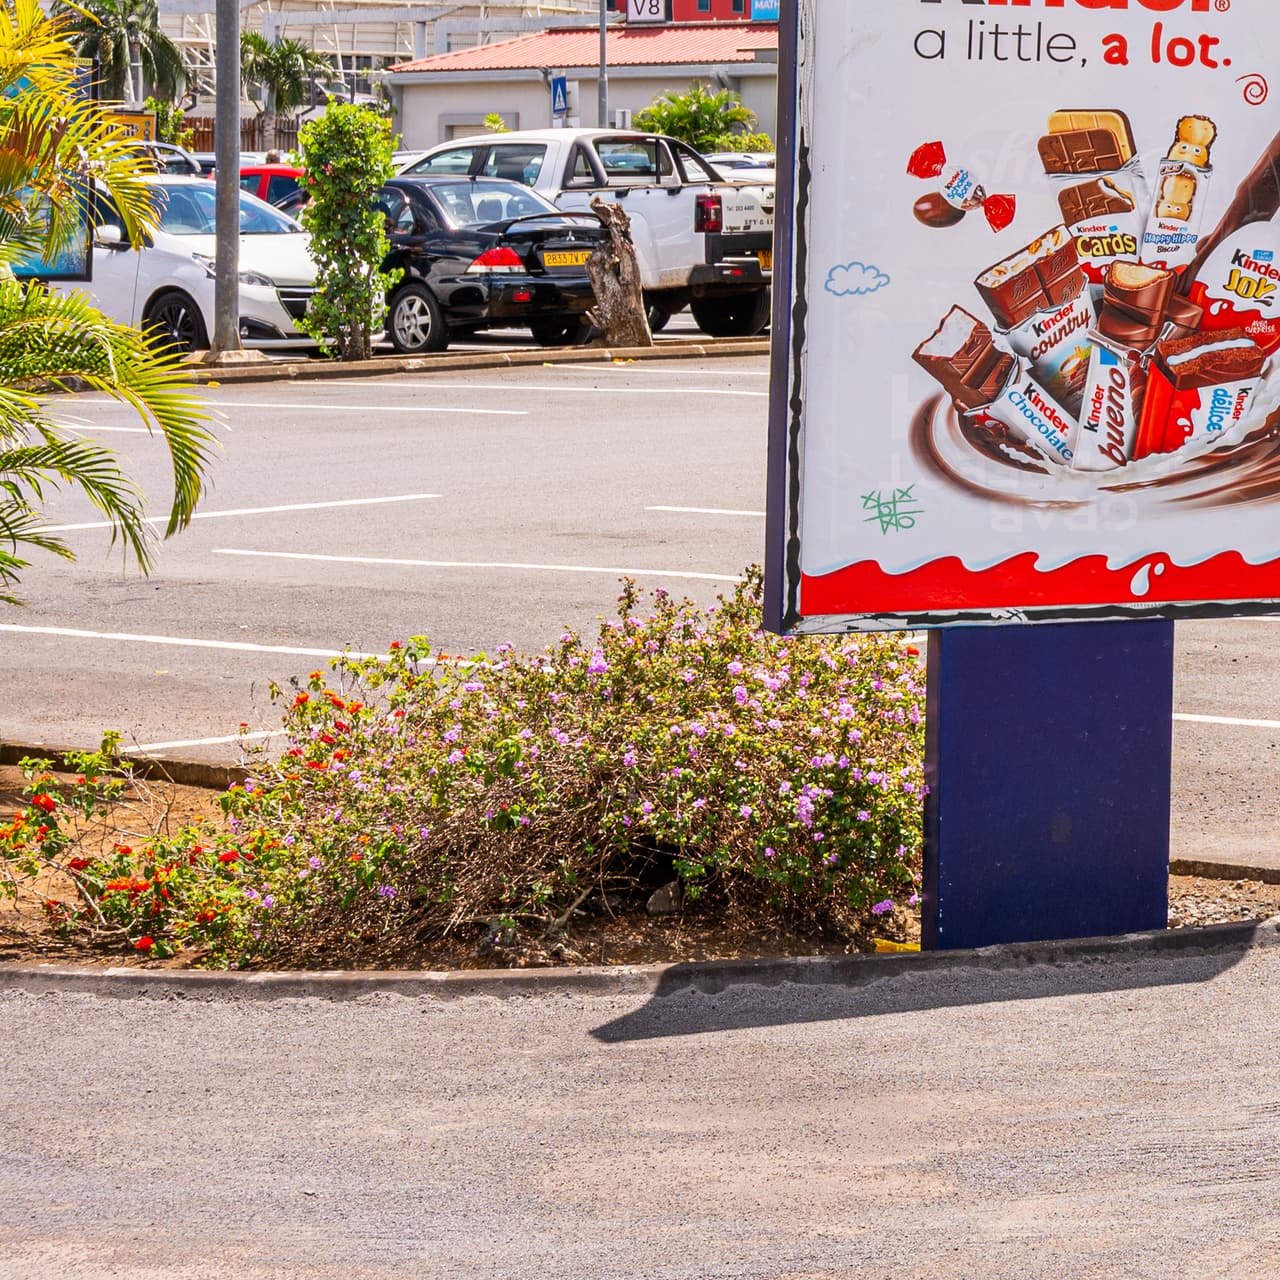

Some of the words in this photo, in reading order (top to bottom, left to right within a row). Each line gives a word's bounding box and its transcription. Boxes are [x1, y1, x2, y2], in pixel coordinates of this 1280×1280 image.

[913, 29, 946, 60] a
[967, 19, 1088, 68] little,
[1101, 33, 1129, 66] a
[1150, 21, 1232, 69] lot.
[1076, 224, 1107, 233] Kinder
[1076, 233, 1137, 257] Cards
[1156, 245, 1180, 254] Biscuit
[1157, 222, 1179, 232] Kinder
[1030, 308, 1091, 361] country
[1032, 302, 1075, 338] Kinder
[1007, 391, 1074, 461] Chocolate
[1022, 382, 1069, 435] Kinder
[1083, 384, 1105, 433] Kinder
[1098, 367, 1128, 467] bueno
[1206, 387, 1233, 432] délice
[1232, 387, 1253, 421] Kinder
